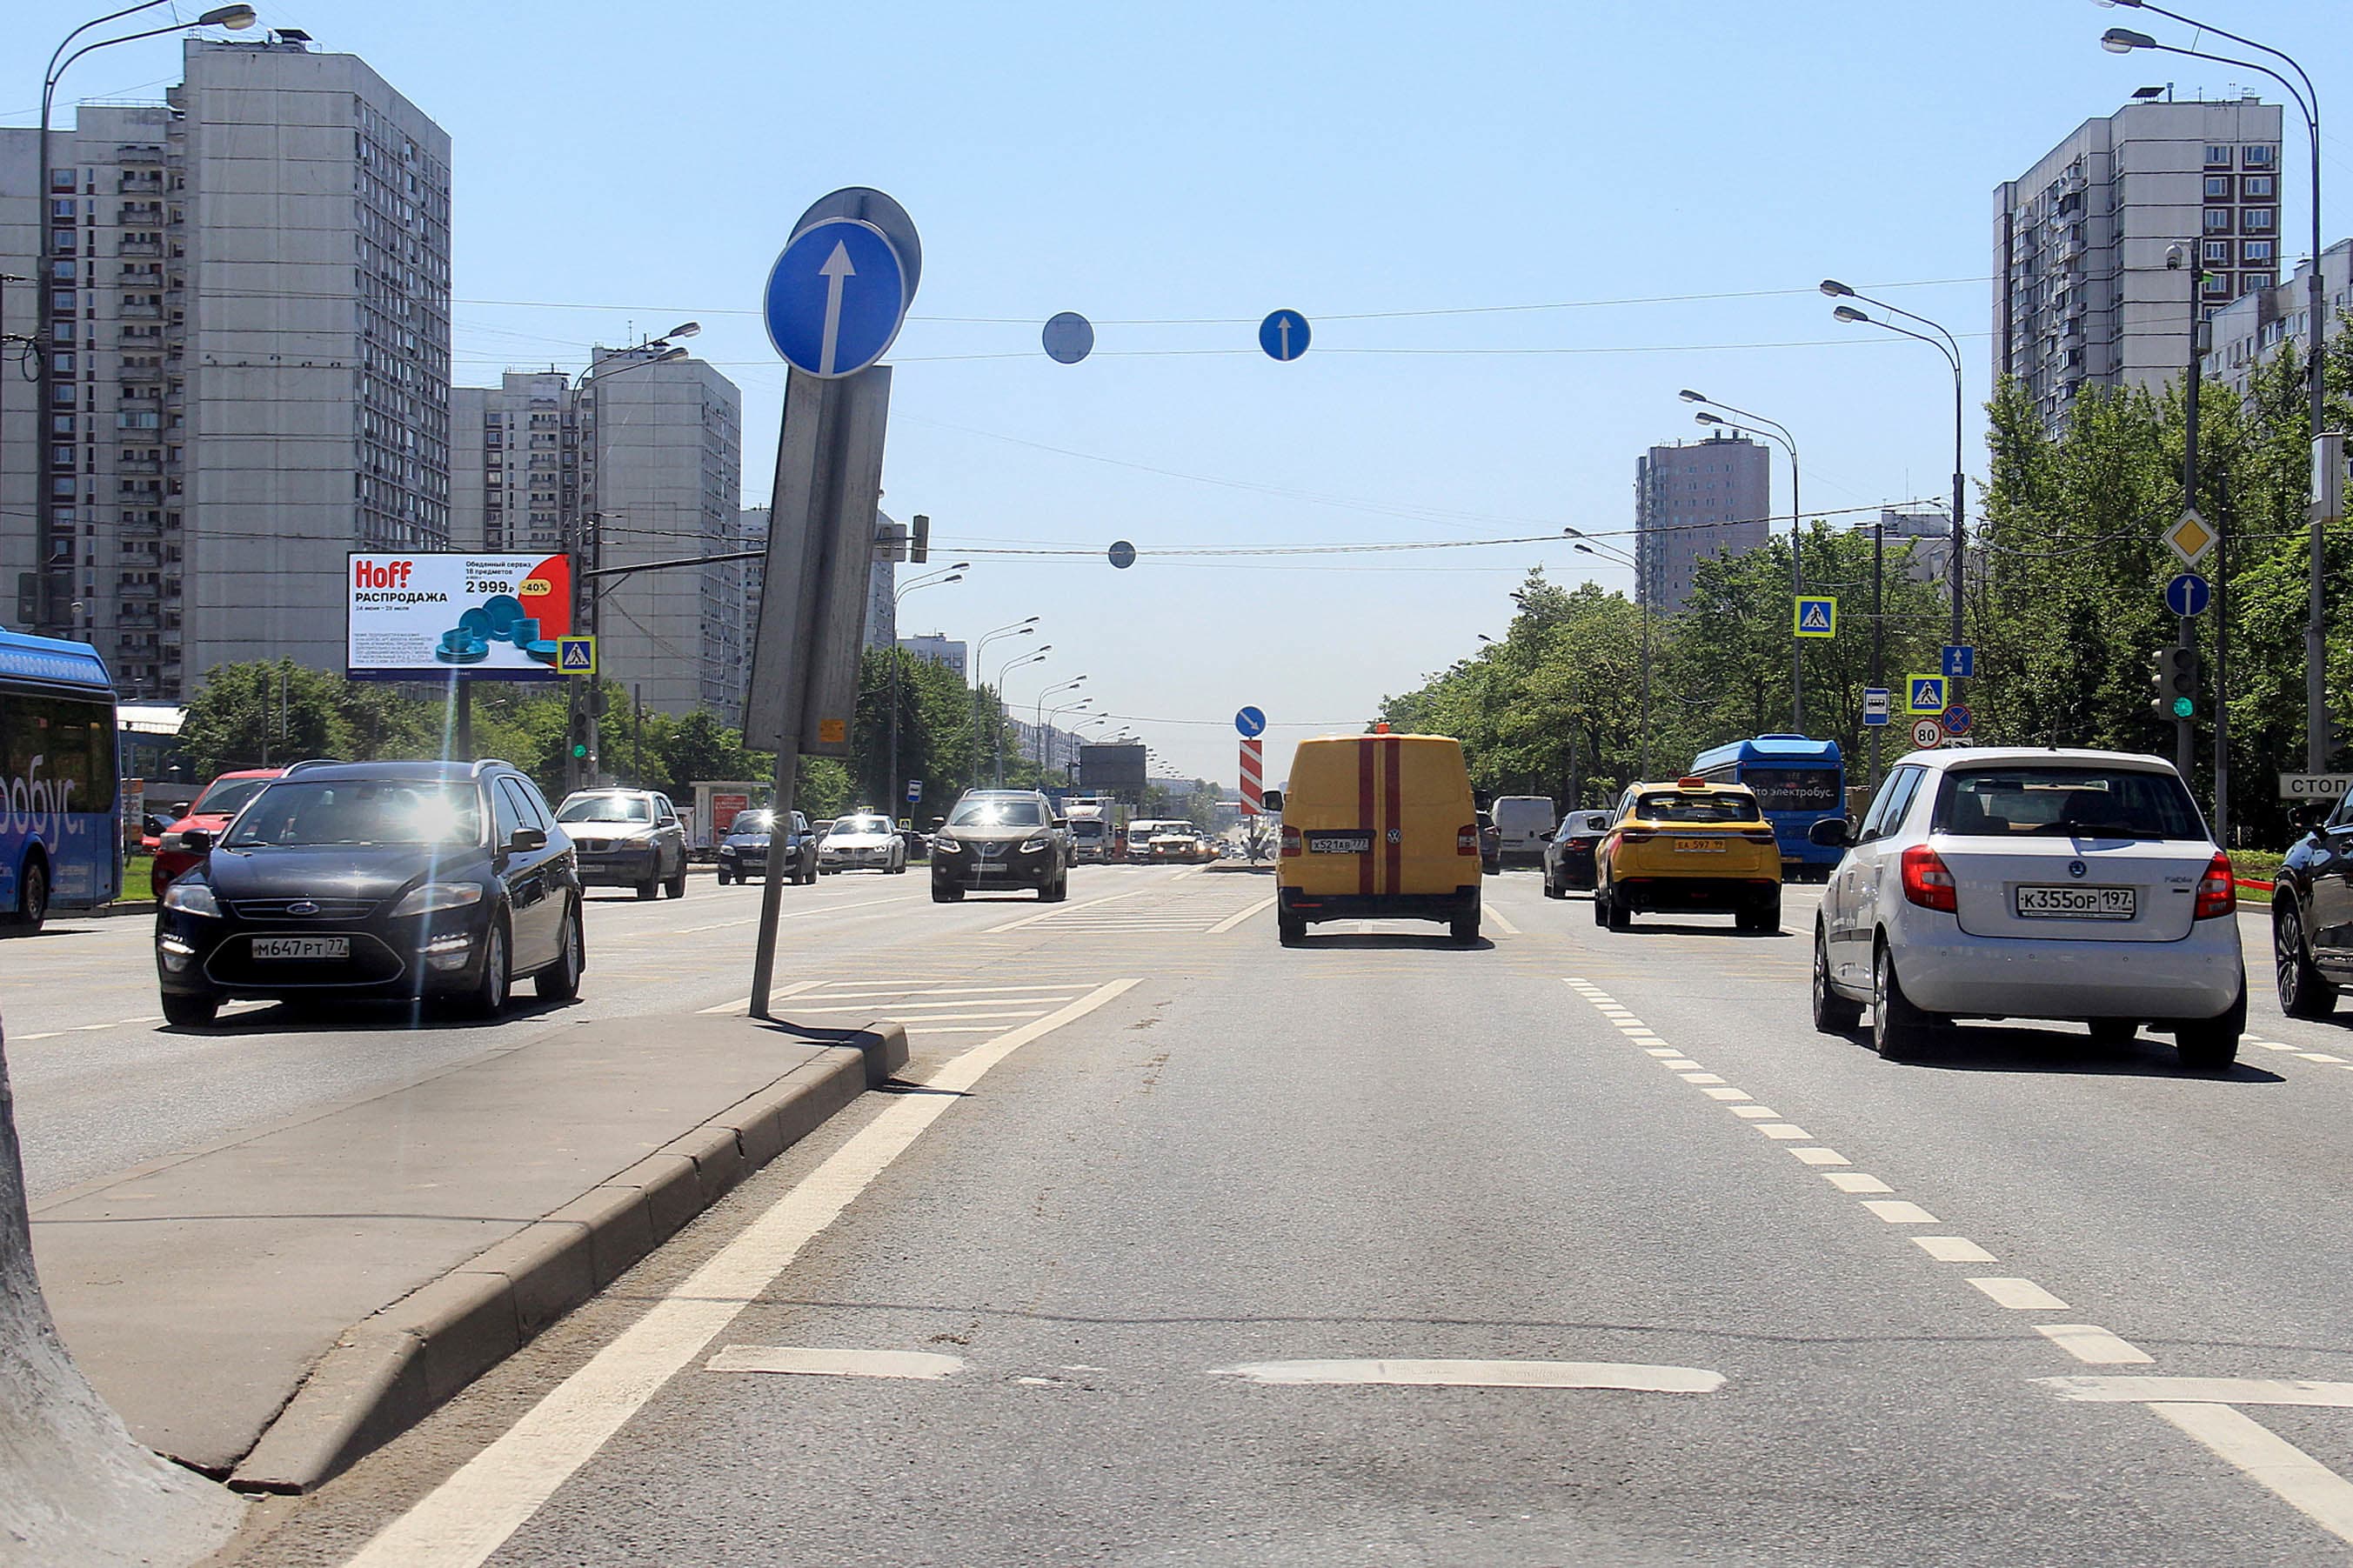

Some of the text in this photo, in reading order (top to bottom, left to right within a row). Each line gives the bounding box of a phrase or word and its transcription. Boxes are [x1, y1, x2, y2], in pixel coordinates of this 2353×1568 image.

[356, 560, 413, 589] Hoff
[522, 583, 547, 591] -40%
[355, 592, 448, 604] РАСПРОДАЖА
[1918, 729, 1935, 741] 80
[2291, 779, 2347, 792] СТОП
[1770, 786, 1835, 798] электробус.
